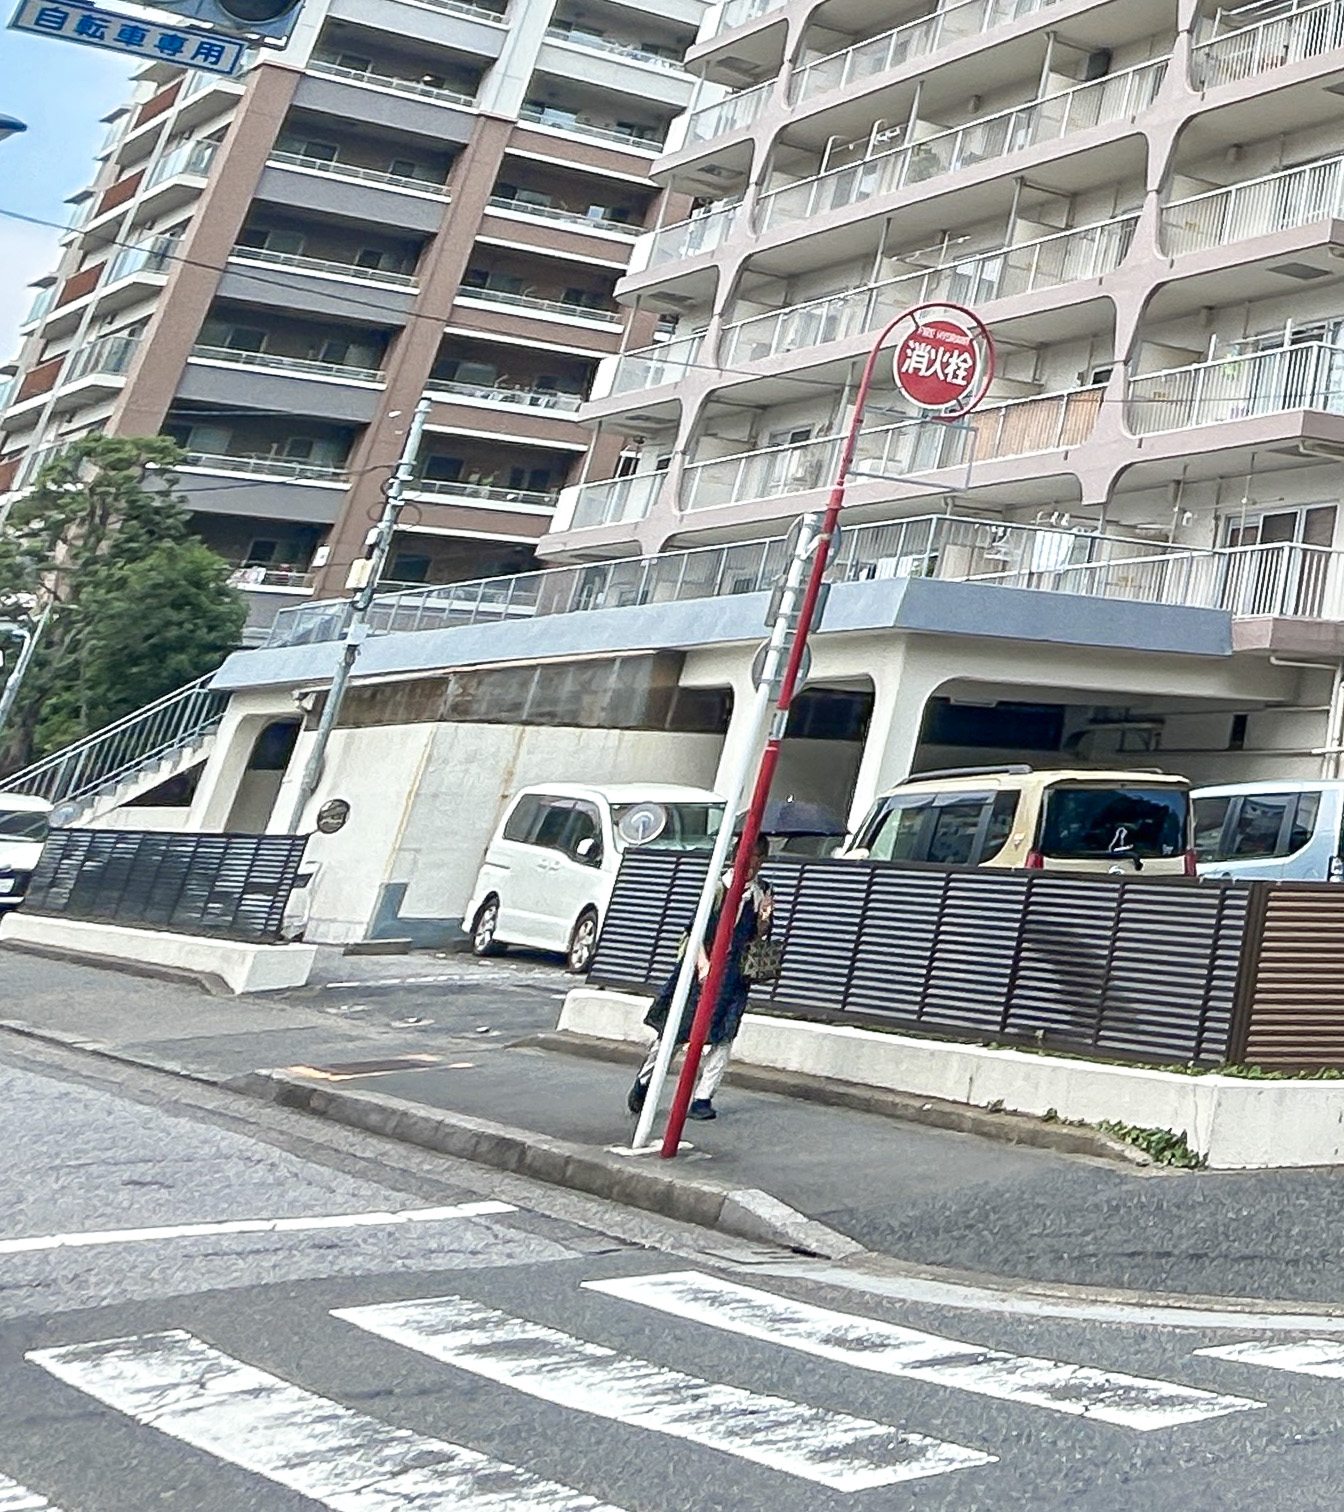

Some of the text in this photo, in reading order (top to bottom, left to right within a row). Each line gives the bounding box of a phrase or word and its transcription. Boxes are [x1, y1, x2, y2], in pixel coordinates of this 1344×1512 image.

[34, 7, 226, 67] 自転車専用
[901, 339, 973, 386] 消火栓
